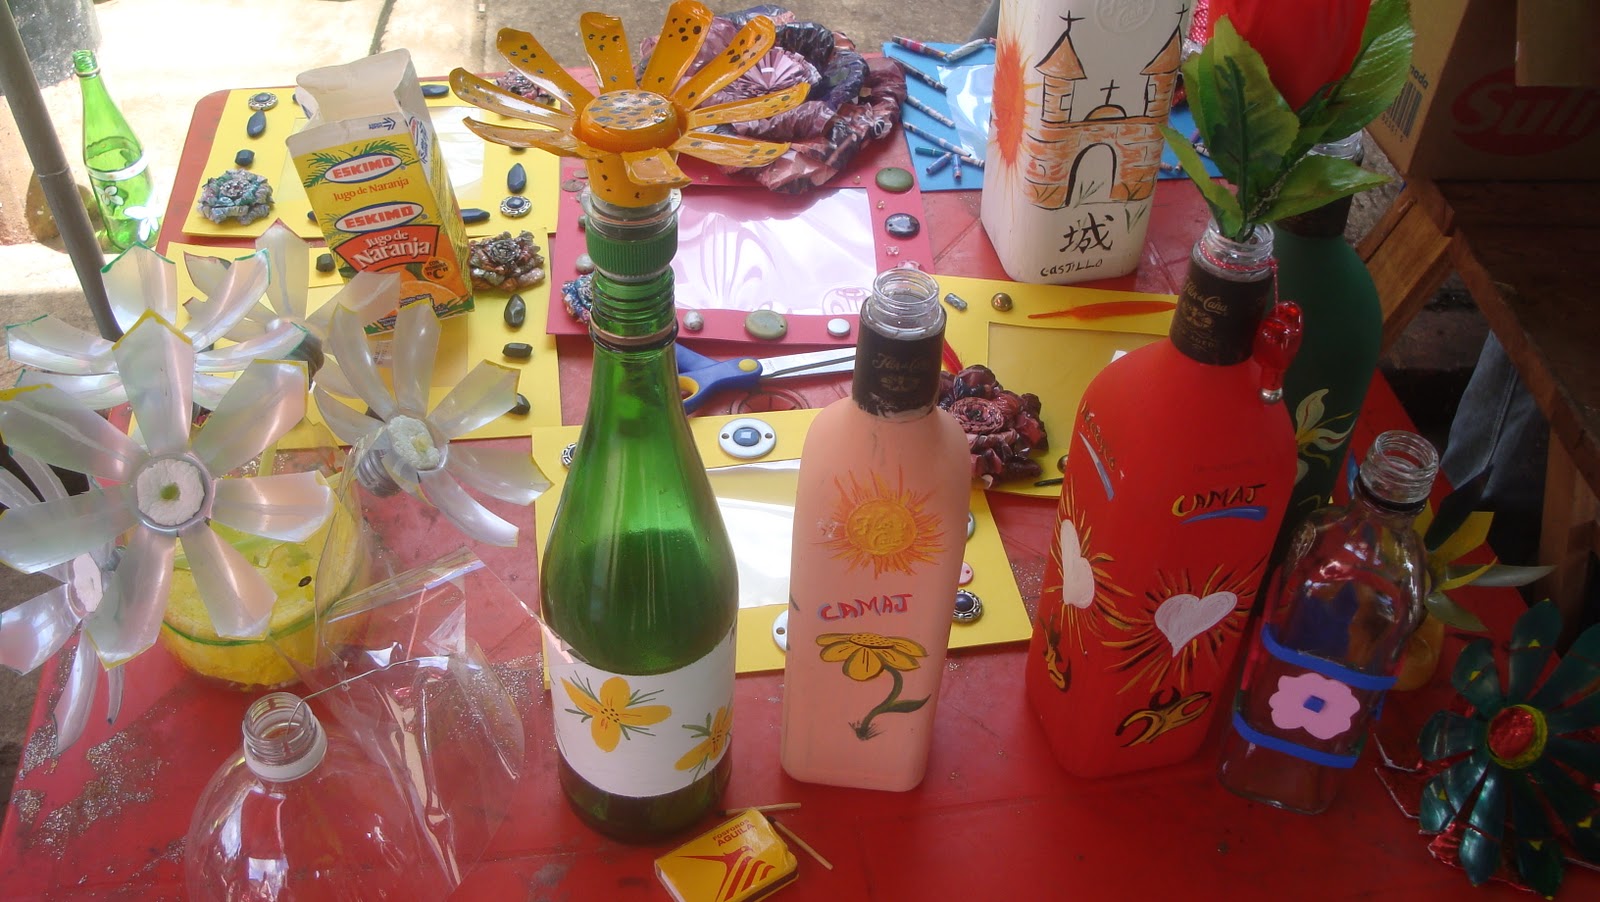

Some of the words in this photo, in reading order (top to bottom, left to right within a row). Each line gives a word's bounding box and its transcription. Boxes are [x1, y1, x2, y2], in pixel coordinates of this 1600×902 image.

[332, 157, 395, 179] ESKIMO
[357, 186, 368, 196] de
[369, 177, 410, 193] Naranja
[344, 205, 414, 229] ESKIMO
[365, 234, 392, 247] Jugo
[393, 230, 410, 240] de
[1059, 211, 1115, 254] 城
[352, 237, 431, 269] Naranja
[1203, 296, 1229, 315] Caña
[1171, 483, 1266, 517] CAMAJ
[818, 594, 912, 621] CAMAJ
[712, 819, 750, 841] FOSFOROS
[717, 823, 755, 847] AGUILA
